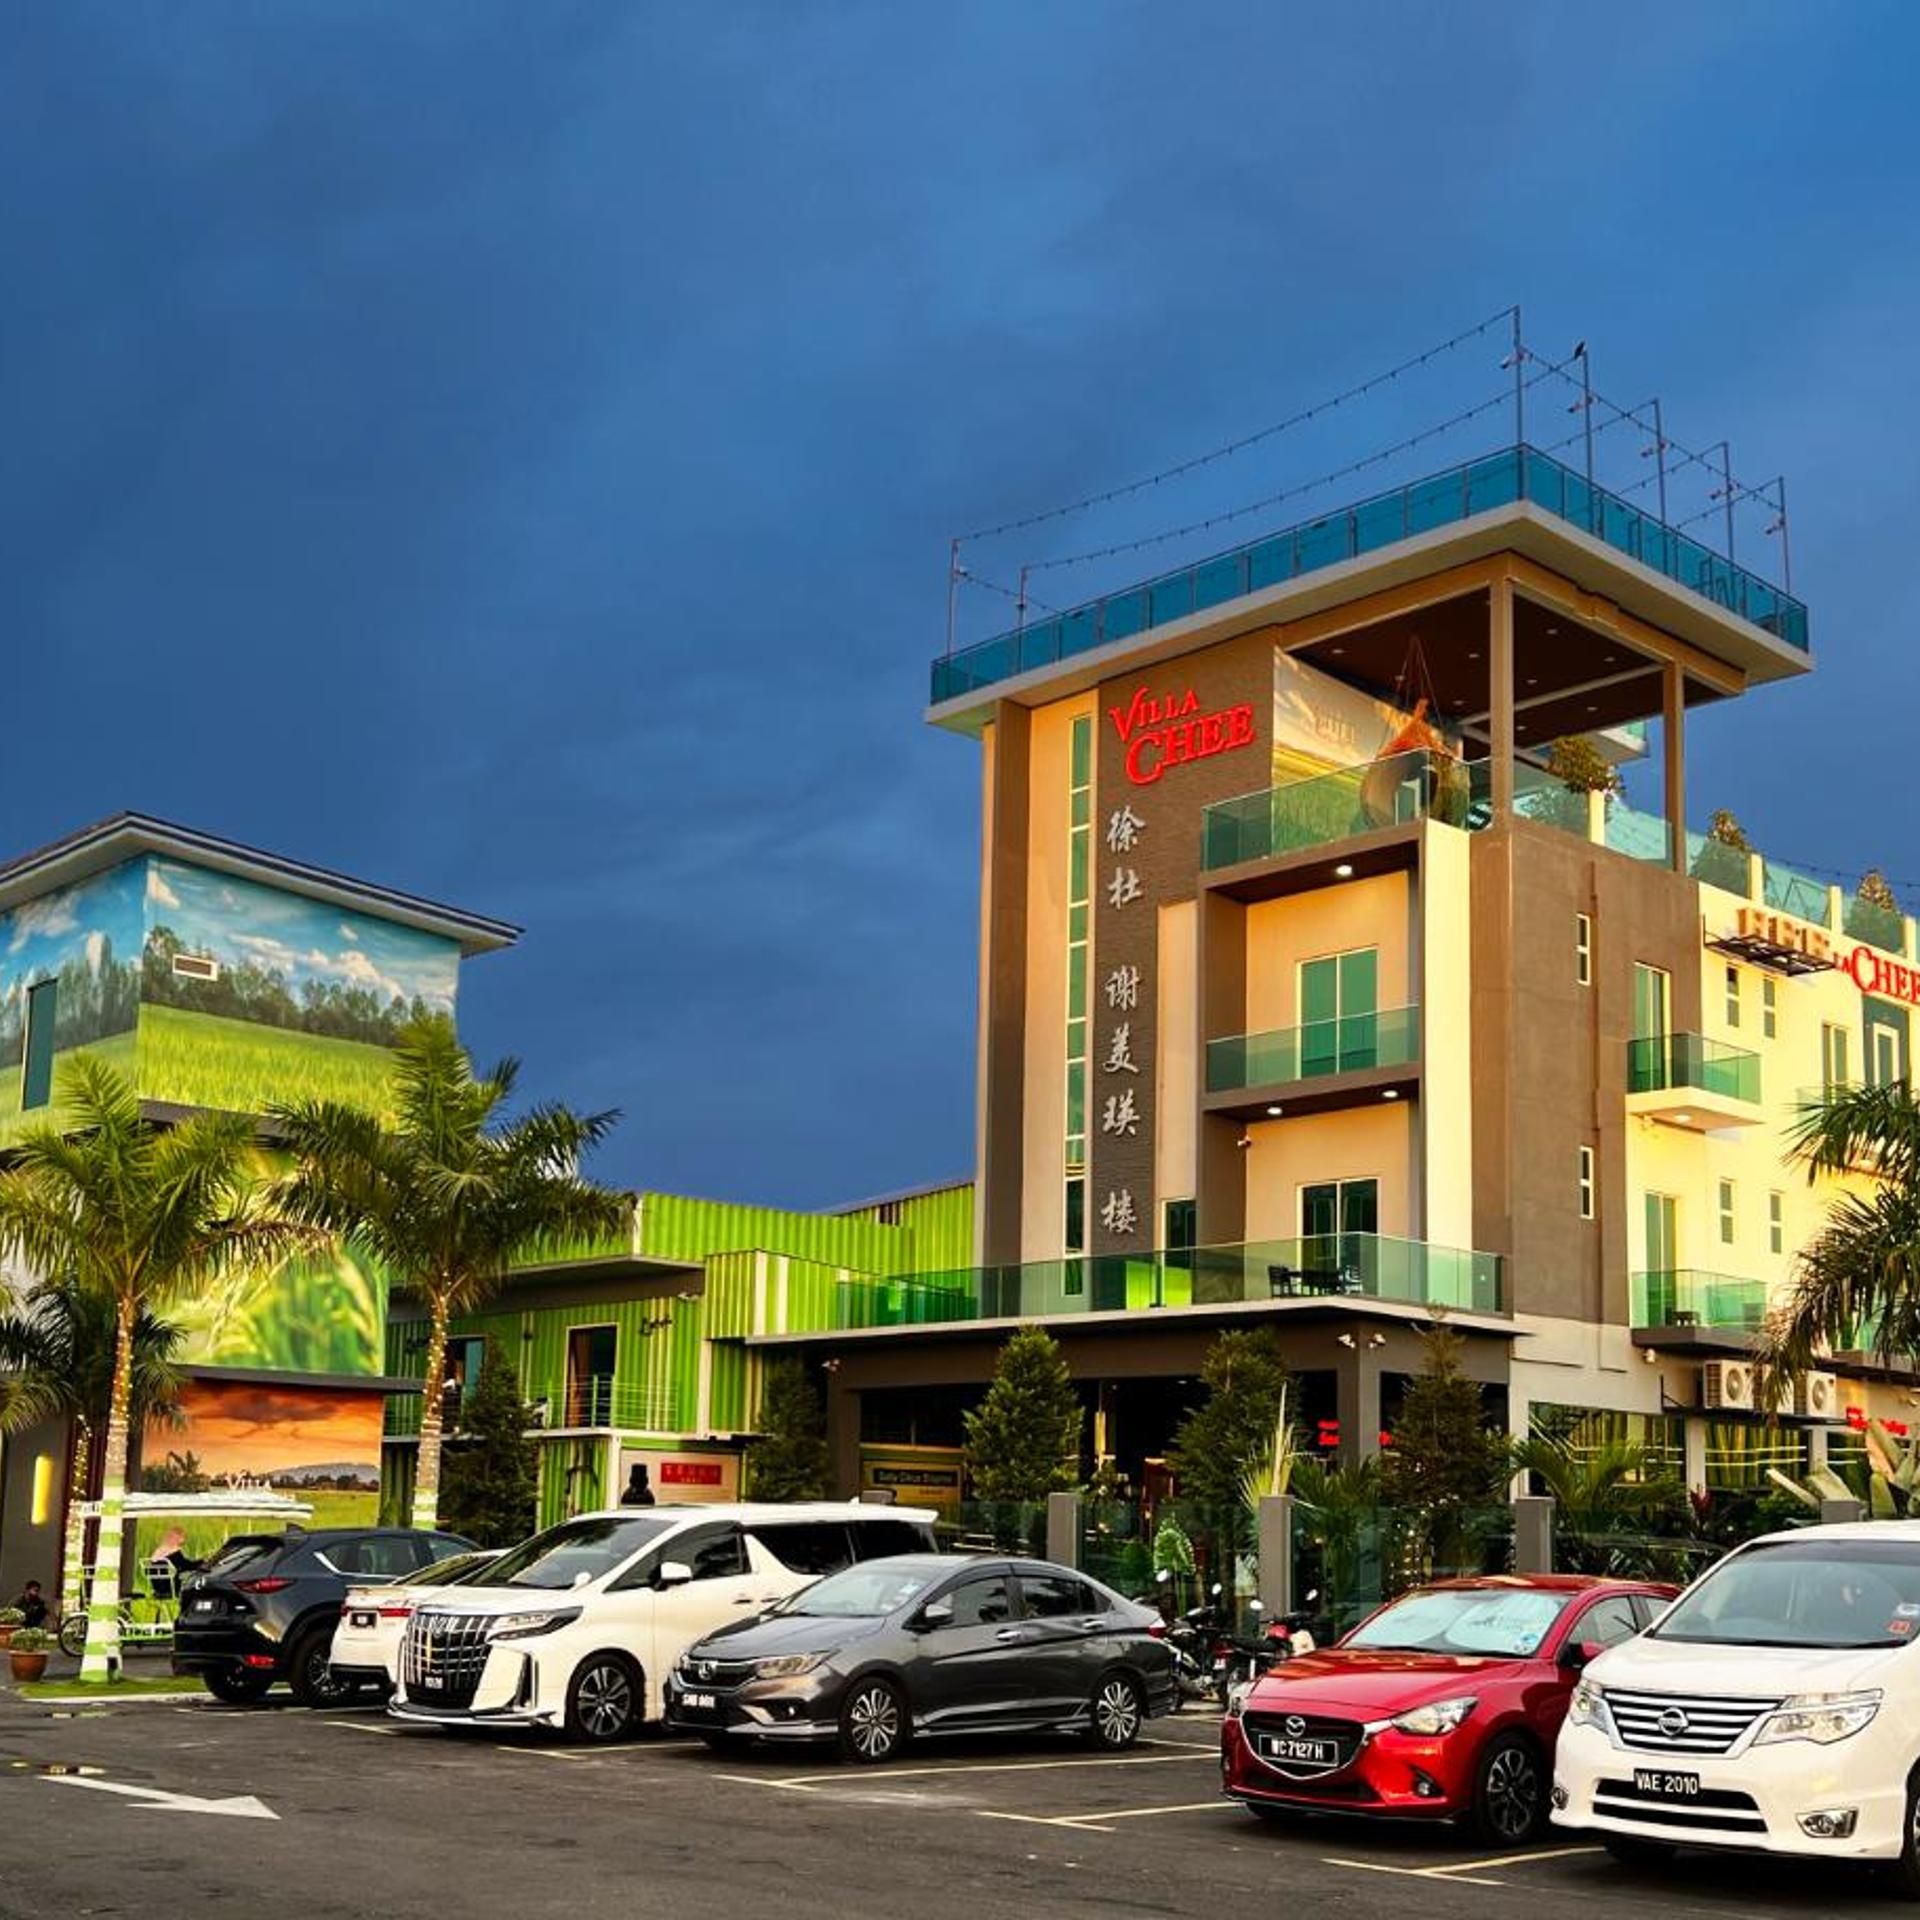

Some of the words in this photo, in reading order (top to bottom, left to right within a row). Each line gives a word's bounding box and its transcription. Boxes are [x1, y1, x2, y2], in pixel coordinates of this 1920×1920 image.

[1109, 685, 1200, 743] VILLA
[1125, 703, 1256, 786] CHEE
[1635, 1772, 1661, 1791] VAE
[1664, 1776, 1698, 1794] 2010
